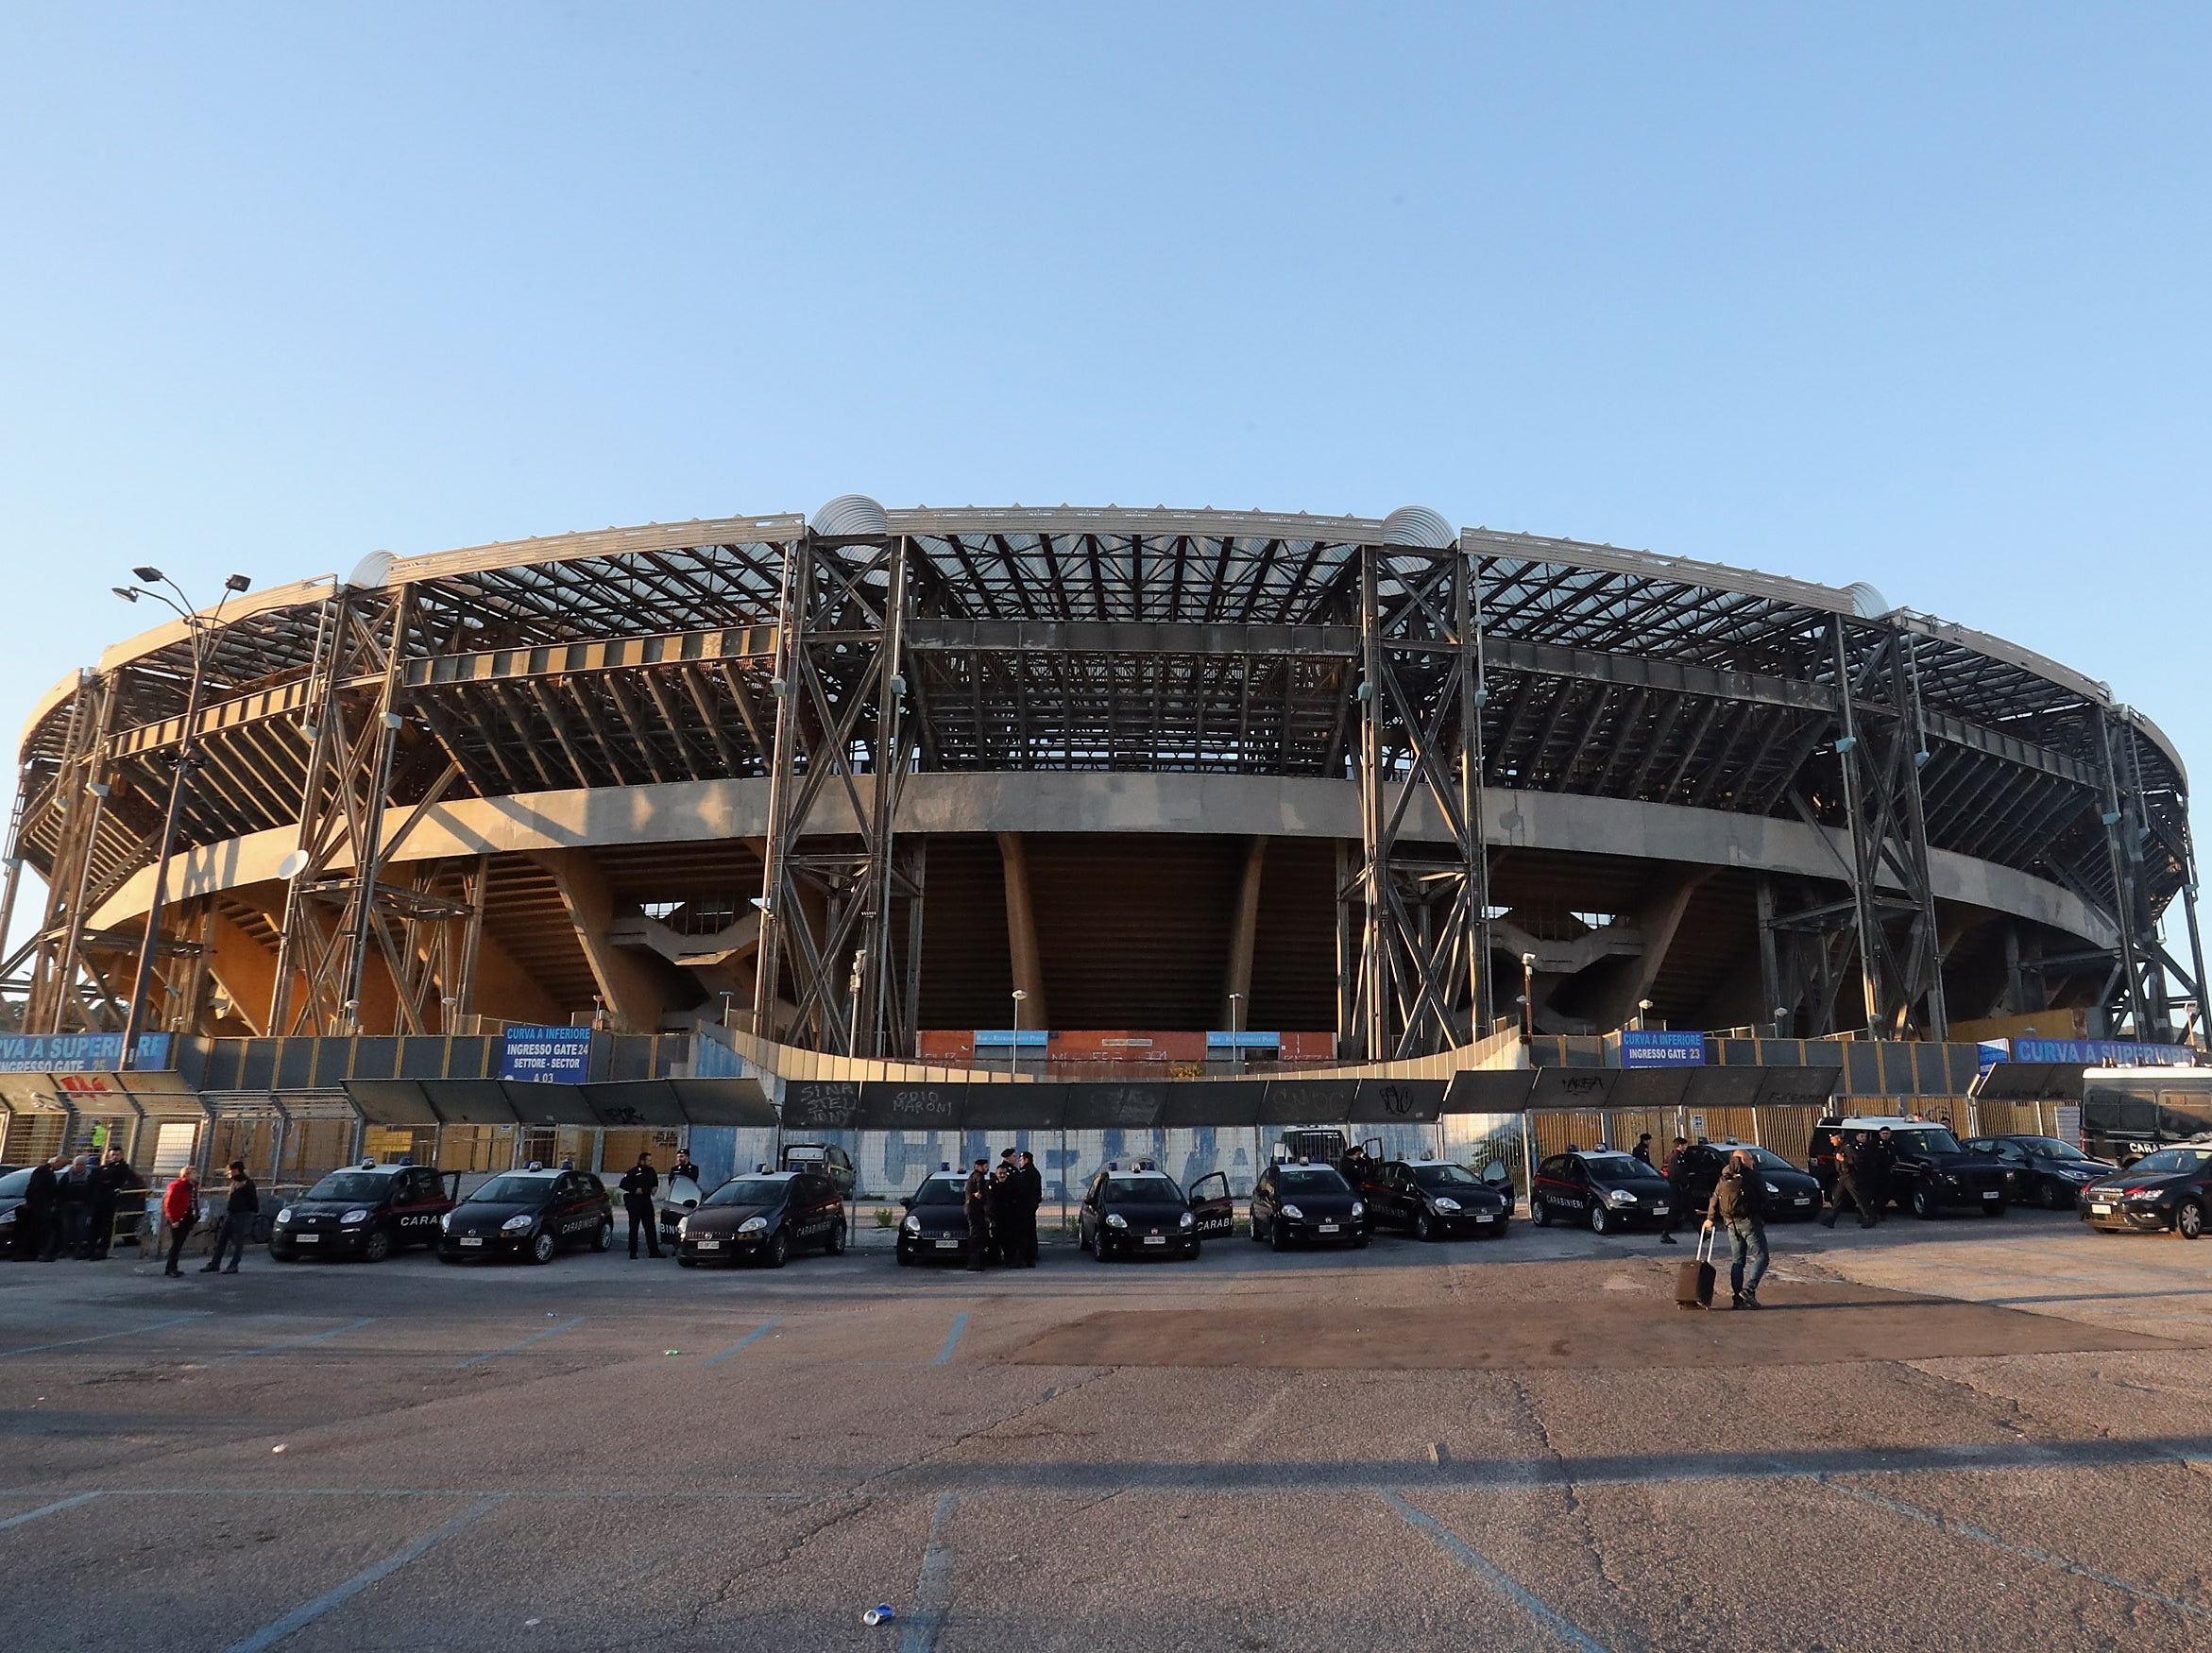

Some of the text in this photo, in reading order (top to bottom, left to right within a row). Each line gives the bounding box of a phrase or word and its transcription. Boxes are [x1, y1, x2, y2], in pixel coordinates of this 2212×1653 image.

[507, 1028, 590, 1040] CURVA A INFERIORE
[1625, 1034, 1701, 1046] CURVA A INFERIORE
[0, 1037, 163, 1059] VA A SUPERIRE
[507, 1044, 588, 1055] INGRESSO GATE 24
[1629, 1048, 1700, 1060] INGRESSO GATE 23
[2017, 1040, 2078, 1063] CURVA
[2084, 1045, 2097, 1063] A
[0, 1060, 51, 1071] NGRESSO
[53, 1060, 84, 1071] GATE
[514, 1058, 546, 1068] SETTORE
[551, 1058, 580, 1068] SECTOR
[1546, 1194, 1584, 1210] CARABINIERI
